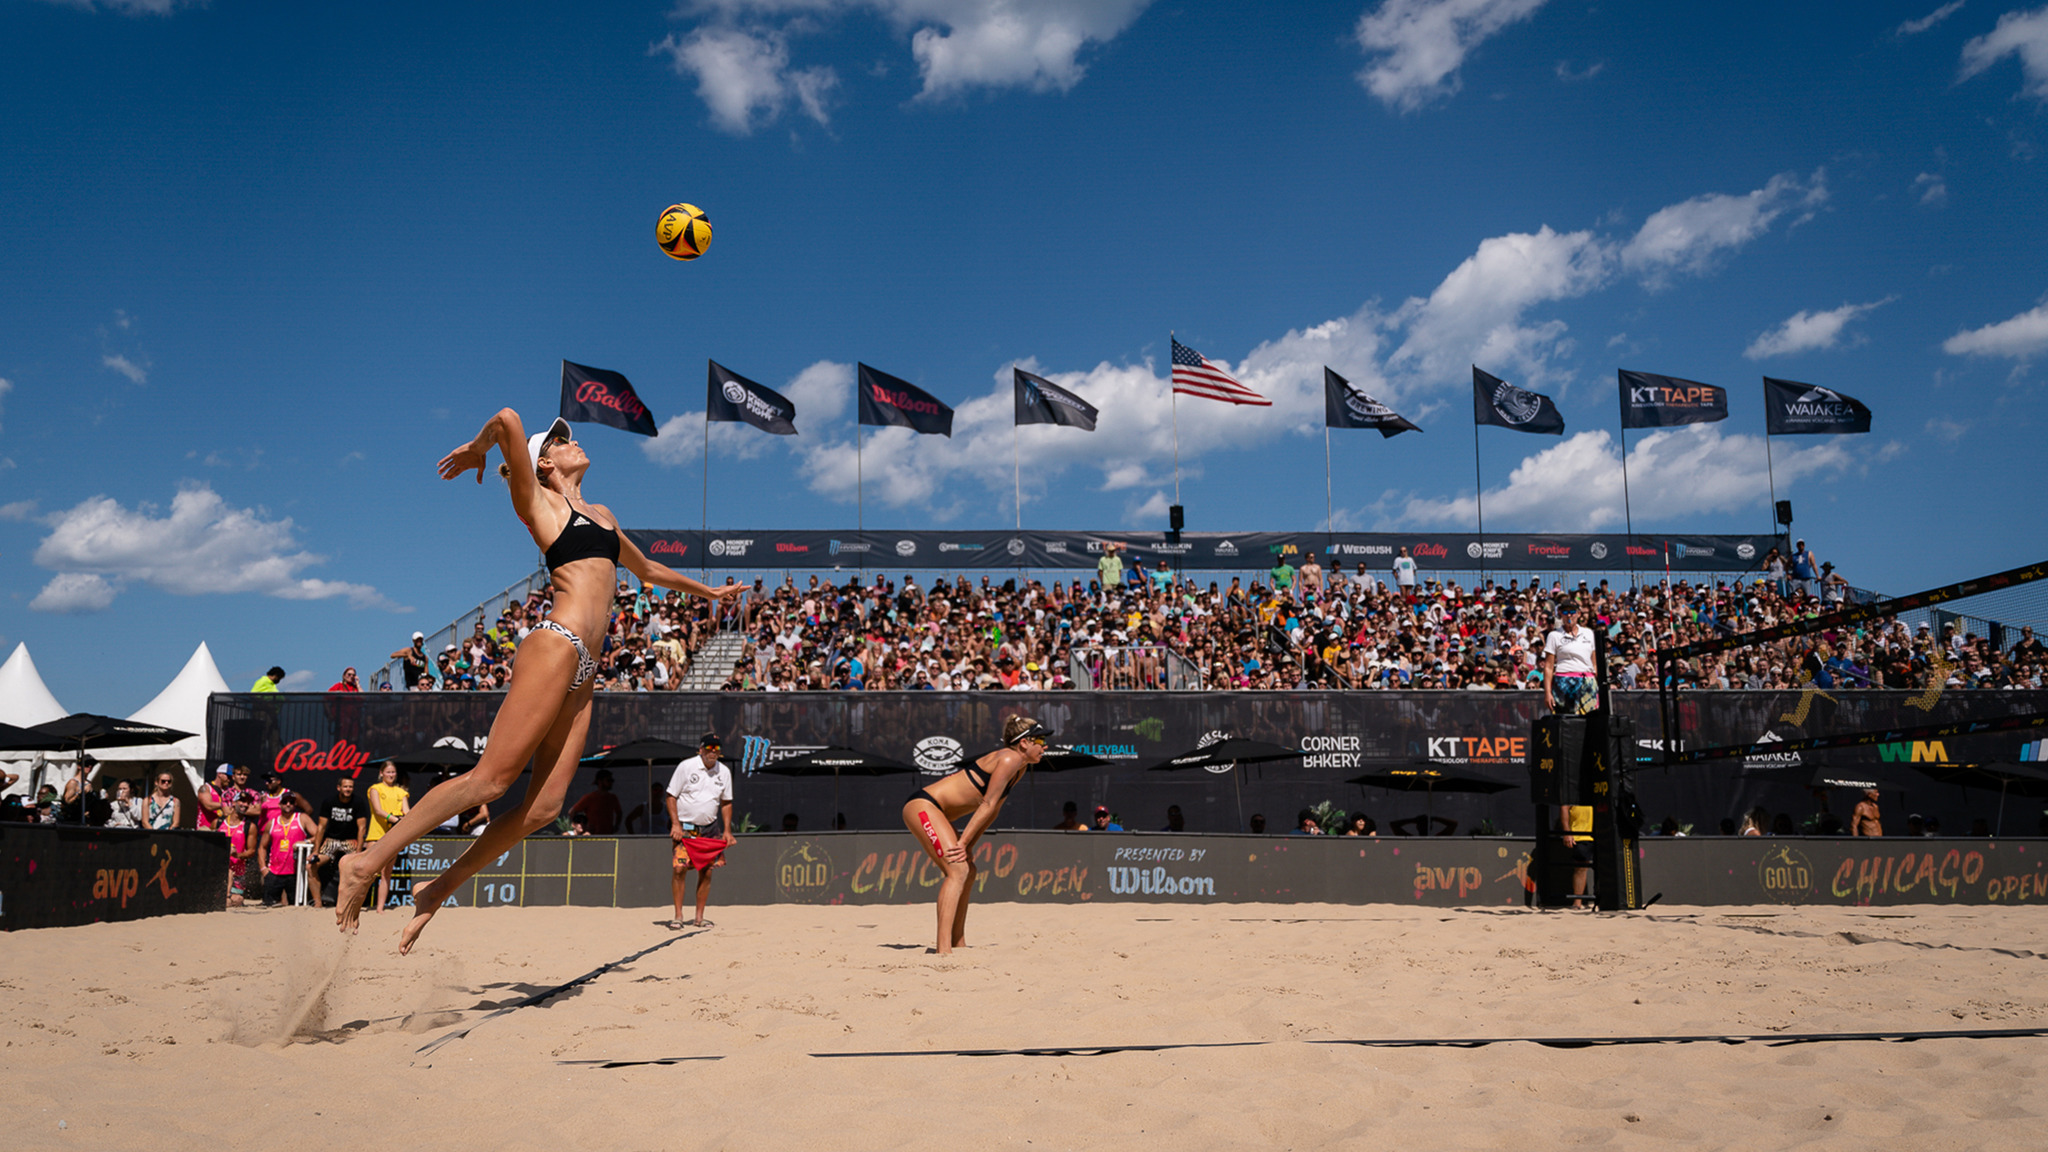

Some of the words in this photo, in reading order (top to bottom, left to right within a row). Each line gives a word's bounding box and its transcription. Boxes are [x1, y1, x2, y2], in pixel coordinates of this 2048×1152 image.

[576, 381, 645, 421] Bally
[872, 384, 939, 415] Wilson
[1631, 387, 1658, 403] KT
[1660, 387, 1714, 403] TAPE
[1349, 400, 1388, 414] BREWING
[1785, 403, 1854, 416] WAIAKEA
[650, 540, 687, 556] Bally
[776, 543, 808, 552] Wilson
[1087, 541, 1100, 550] KT
[1269, 545, 1298, 554] WM
[1342, 544, 1392, 554] WEDBUSH
[1413, 543, 1448, 558] Bally
[1528, 544, 1571, 555] Frontier
[1625, 546, 1656, 556] Wilson
[927, 738, 949, 746] KONA
[1211, 730, 1233, 741] CLA
[1301, 736, 1360, 752] CORNER
[1428, 737, 1460, 758] KT
[1462, 737, 1526, 758] TAPE
[1877, 741, 1949, 762] WM
[274, 738, 370, 779] Bally
[1539, 758, 1553, 773] avp
[1593, 781, 1608, 797] avp
[924, 821, 938, 845] USA
[1114, 848, 1184, 861] PRESENTED
[1189, 848, 1207, 861] BY
[392, 860, 456, 872] LINEMA
[851, 842, 1018, 899] CHICGO
[1832, 849, 1984, 898] CHICAGO
[782, 864, 828, 887] GOLD
[1018, 866, 1088, 895] OPEN
[1107, 867, 1216, 895] Wilson
[1413, 866, 1482, 898] avp
[1765, 868, 1808, 889] GOLD
[93, 868, 139, 908] avp
[483, 884, 516, 903] 10
[1987, 872, 2048, 901] OPEN
